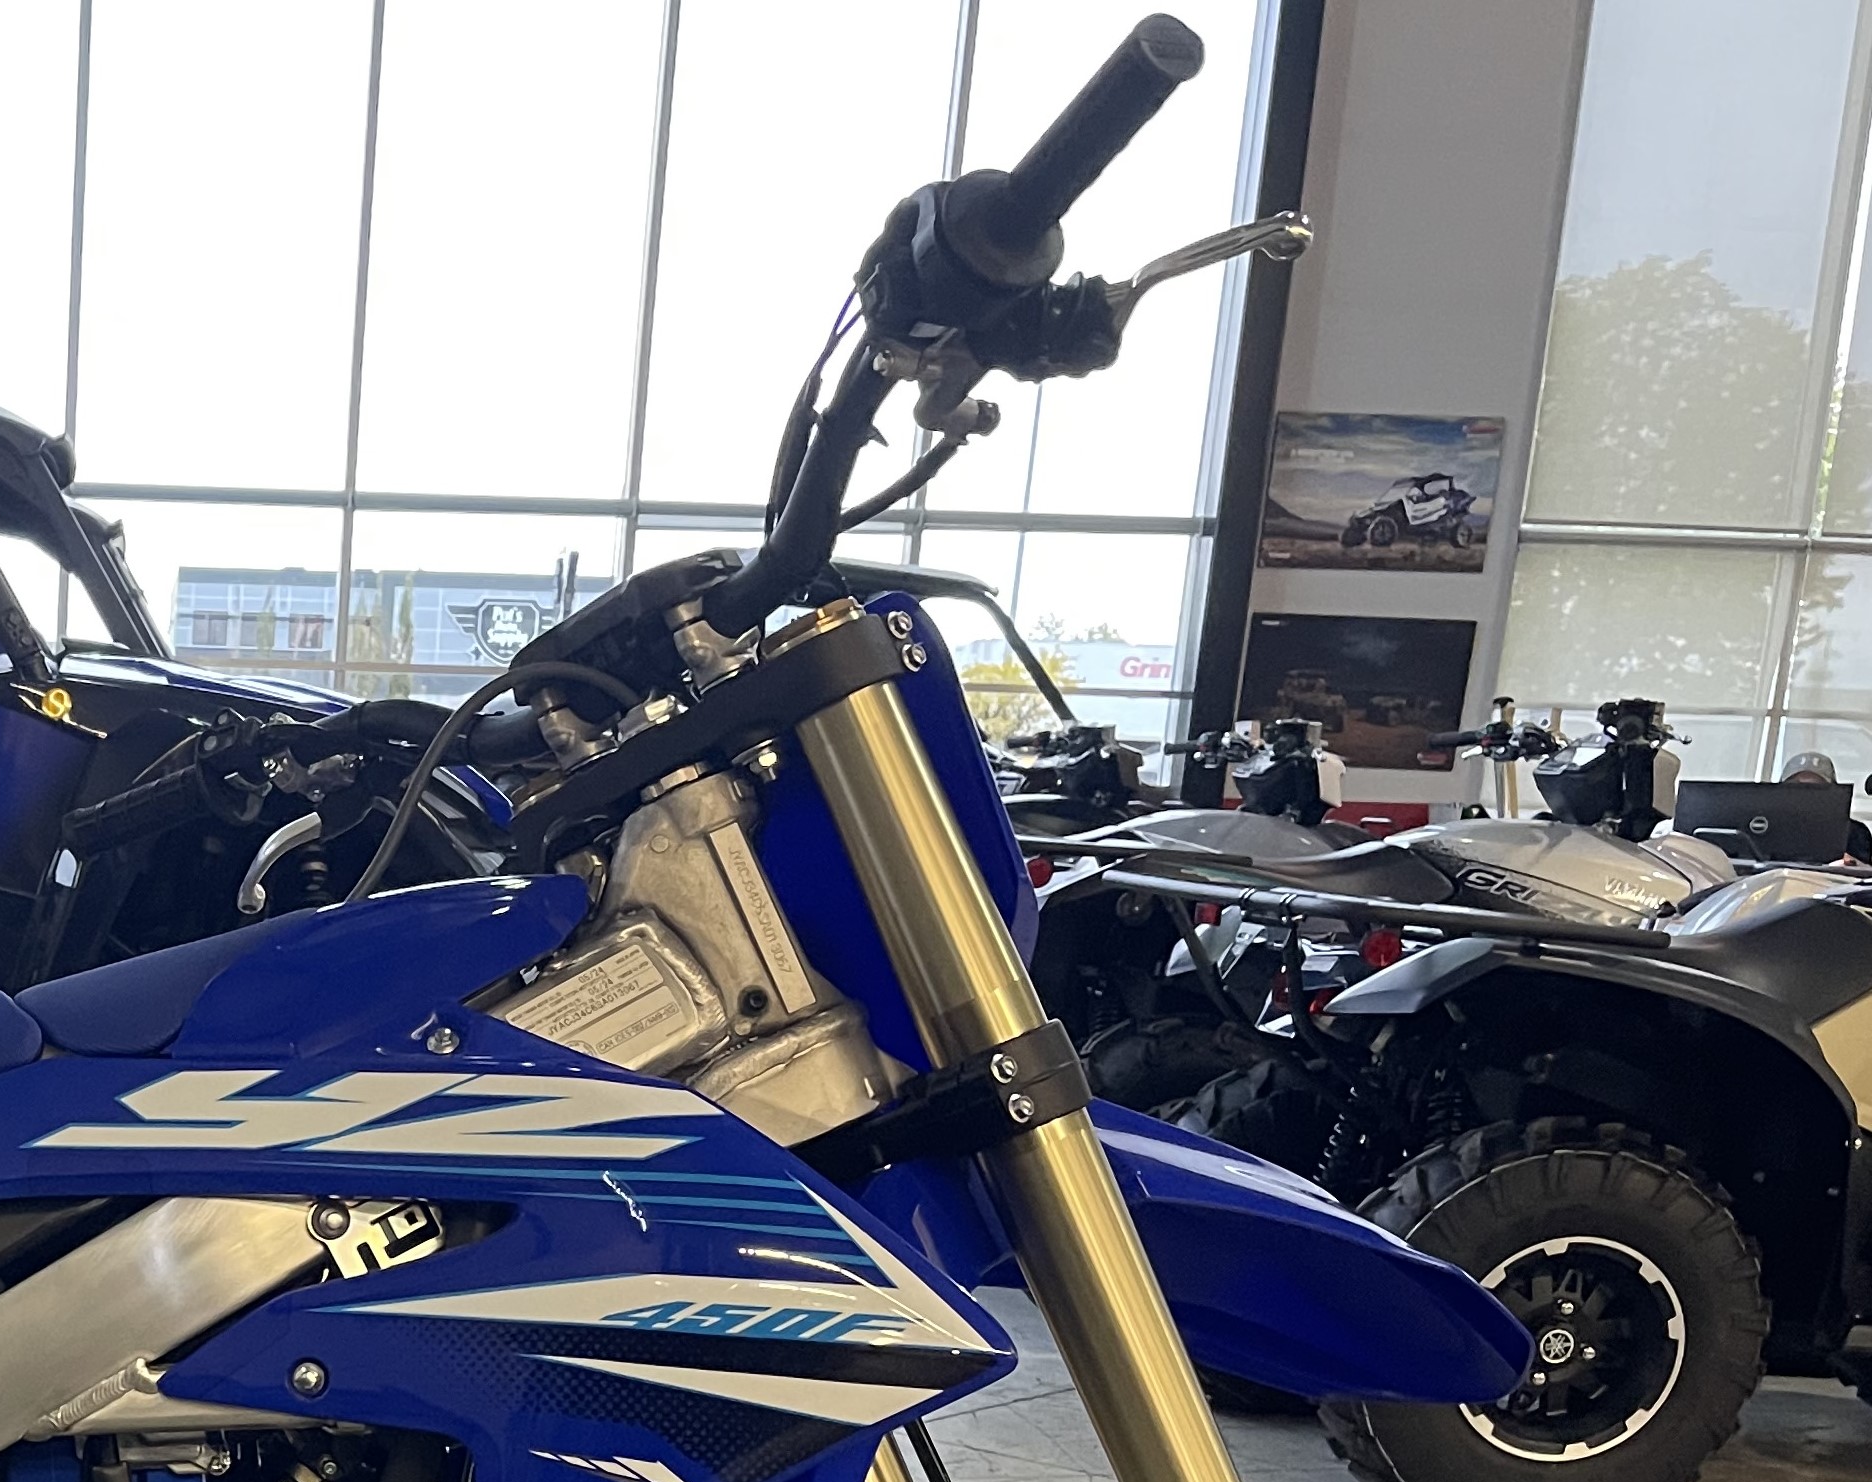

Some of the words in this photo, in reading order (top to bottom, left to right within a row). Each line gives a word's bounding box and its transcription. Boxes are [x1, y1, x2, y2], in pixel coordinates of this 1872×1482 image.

[578, 966, 606, 984] 05/24
[588, 979, 614, 997] 05/24
[20, 1069, 725, 1159] YZ
[599, 1300, 922, 1343] 450F
